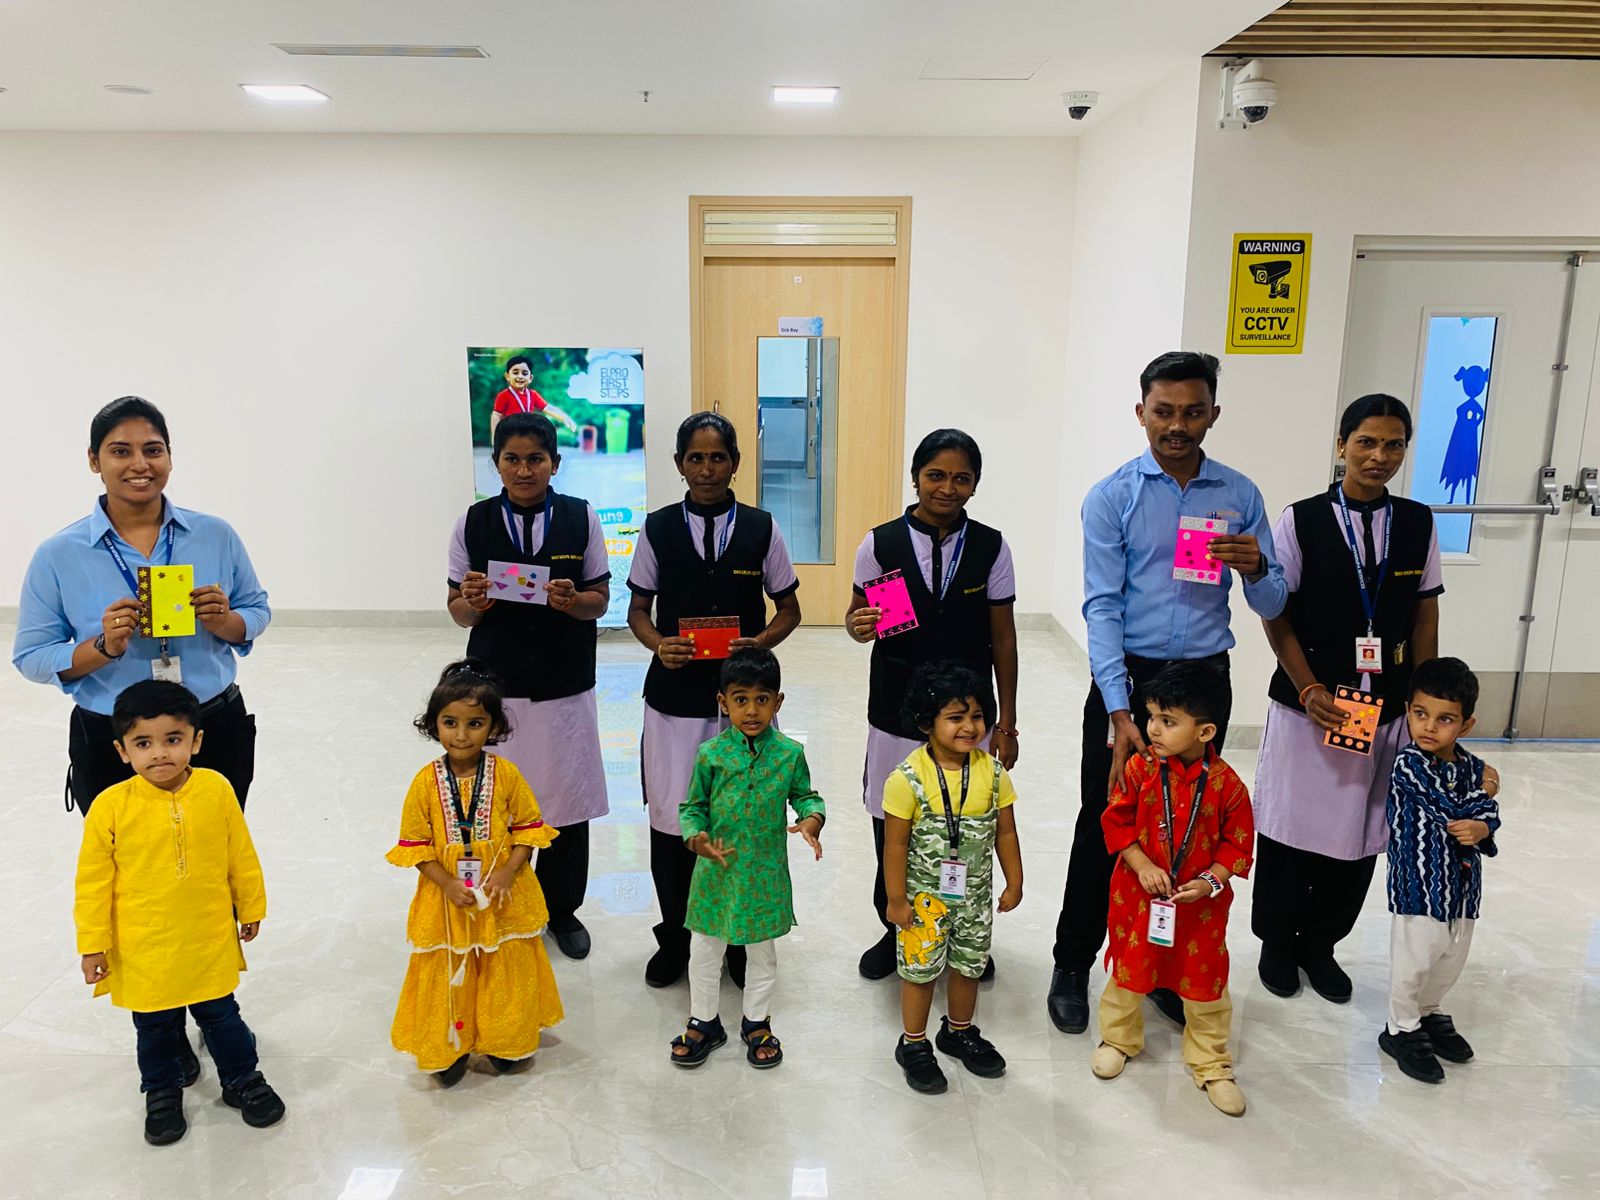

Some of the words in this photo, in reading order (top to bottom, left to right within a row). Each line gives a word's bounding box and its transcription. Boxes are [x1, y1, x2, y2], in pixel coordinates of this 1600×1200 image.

[1243, 242, 1301, 252] WARNING
[1244, 316, 1289, 331] CCTV
[600, 378, 628, 388] FIRST
